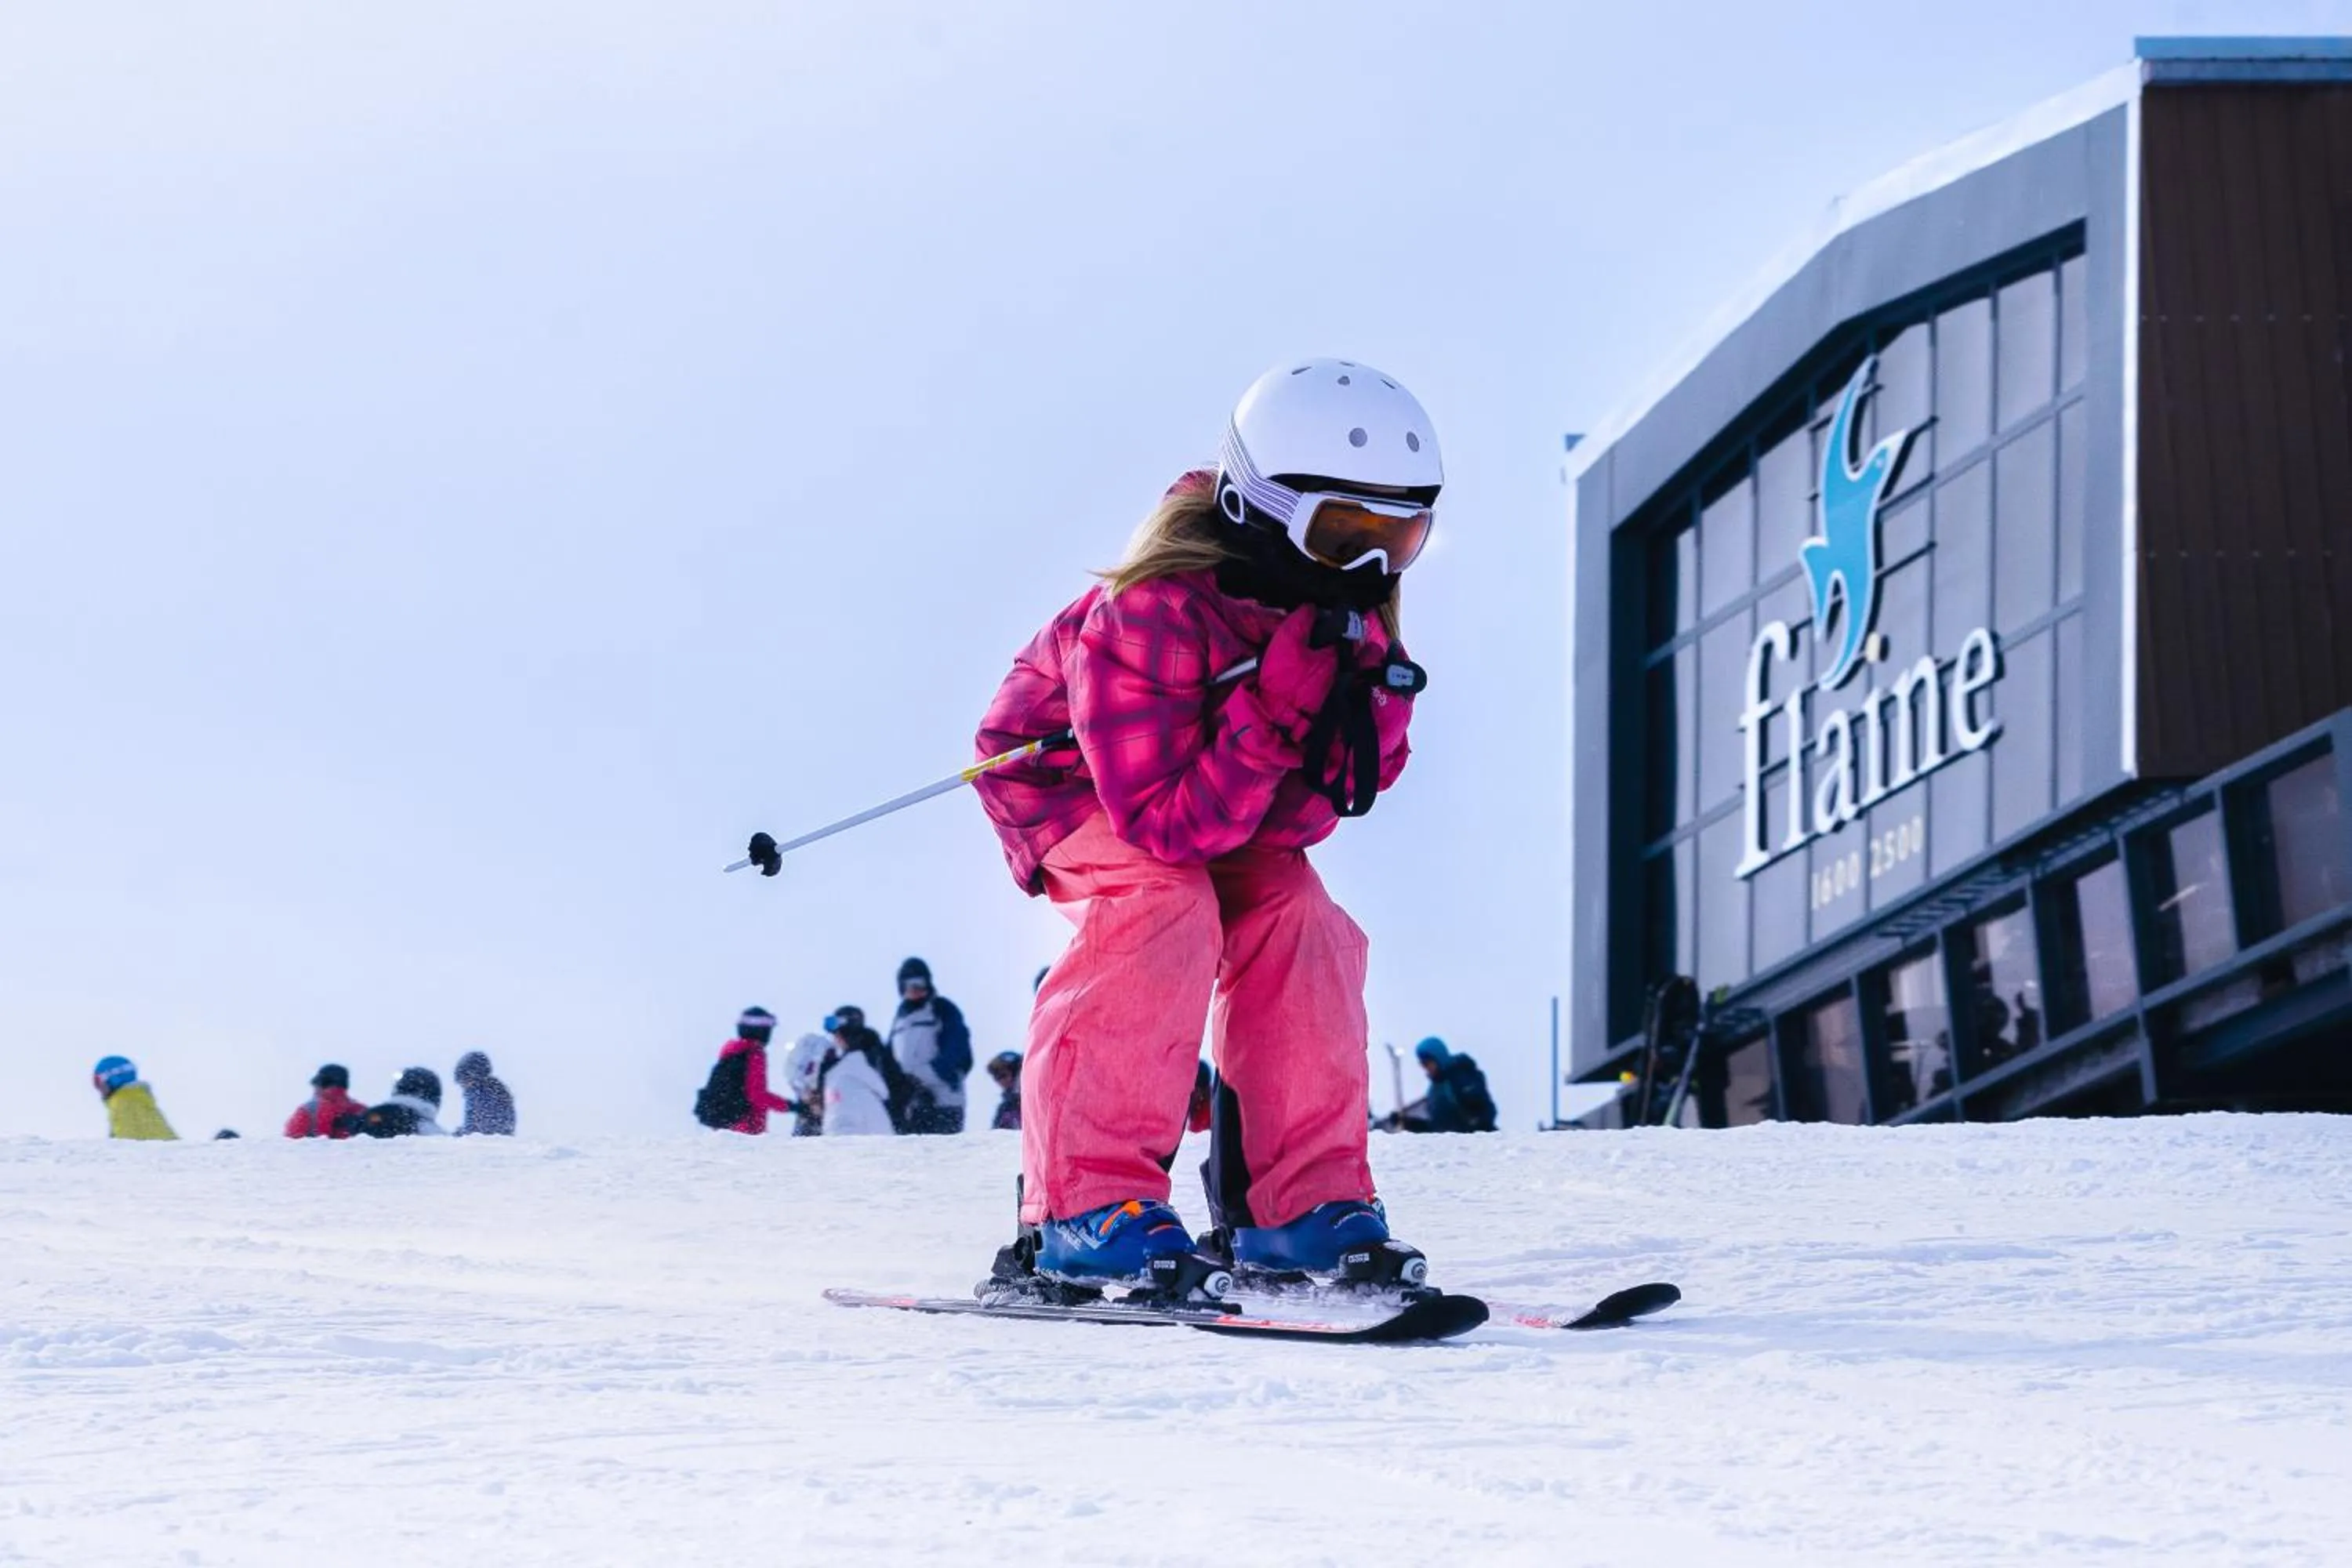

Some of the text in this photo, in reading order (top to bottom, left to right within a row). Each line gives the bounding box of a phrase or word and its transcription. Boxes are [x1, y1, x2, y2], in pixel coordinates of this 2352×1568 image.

[1734, 620, 2001, 880] flaine
[1812, 815, 1923, 910] 1600 2500
